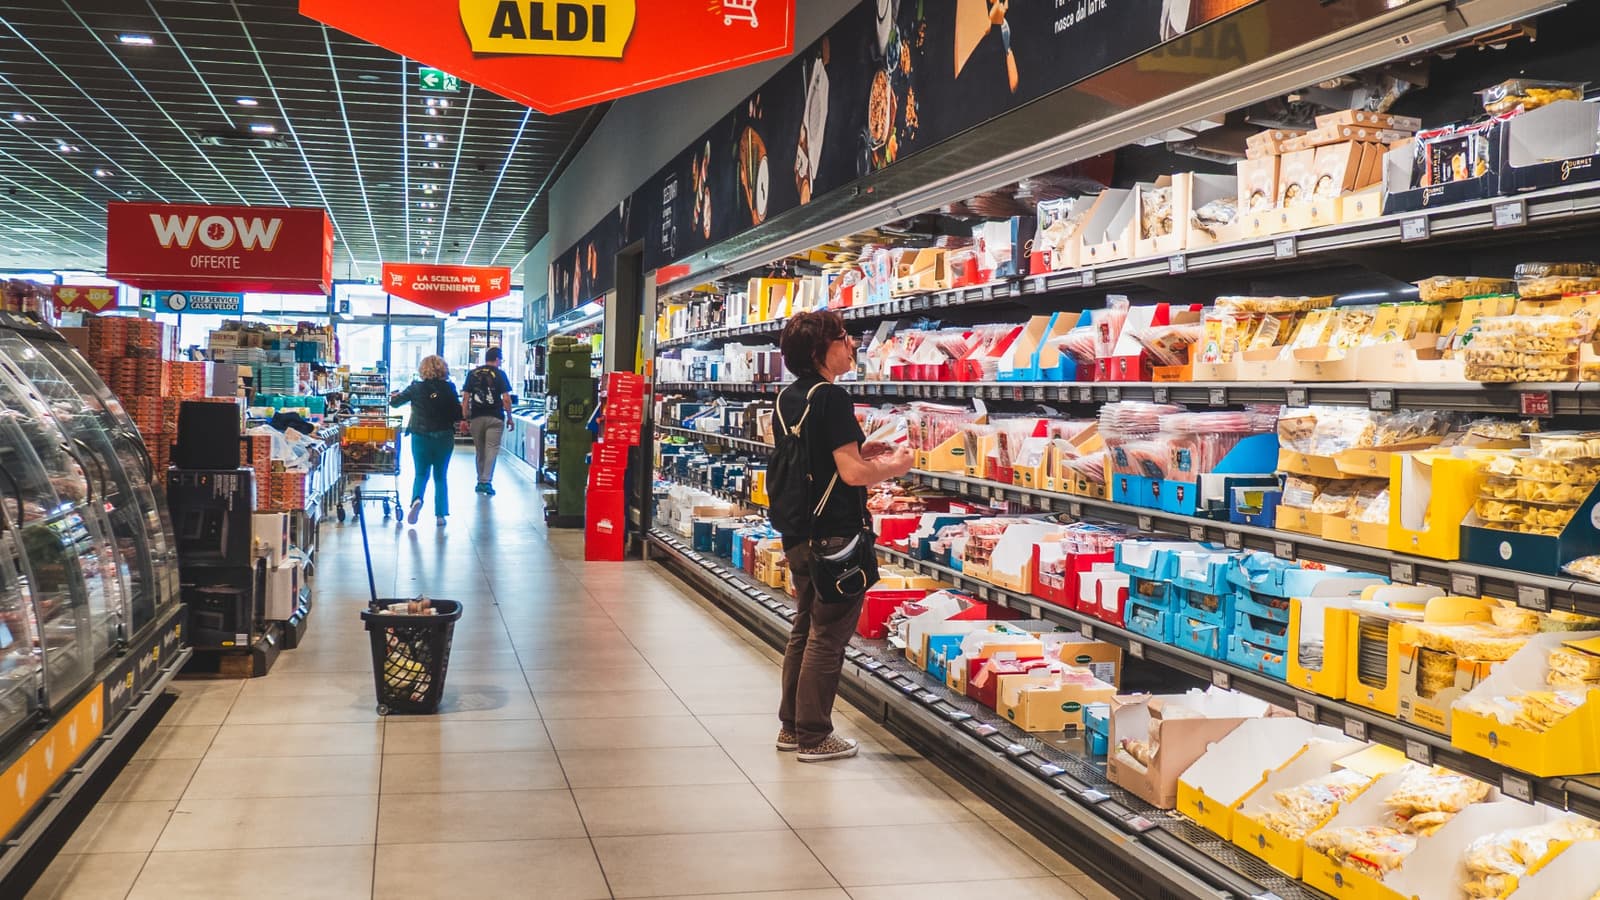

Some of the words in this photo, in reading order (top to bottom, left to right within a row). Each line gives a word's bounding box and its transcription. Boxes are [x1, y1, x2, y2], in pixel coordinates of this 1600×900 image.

[1075, 0, 1087, 23] dal
[488, 0, 606, 43] ALDI
[150, 213, 283, 252] WOW
[190, 255, 241, 269] OFFERTE
[431, 275, 460, 283] SCELTA
[462, 274, 477, 284] PIÙ
[412, 282, 481, 293] CONVENIENTE
[142, 297, 151, 306] 4
[191, 295, 208, 303] SELF
[191, 302, 213, 310] CASSE
